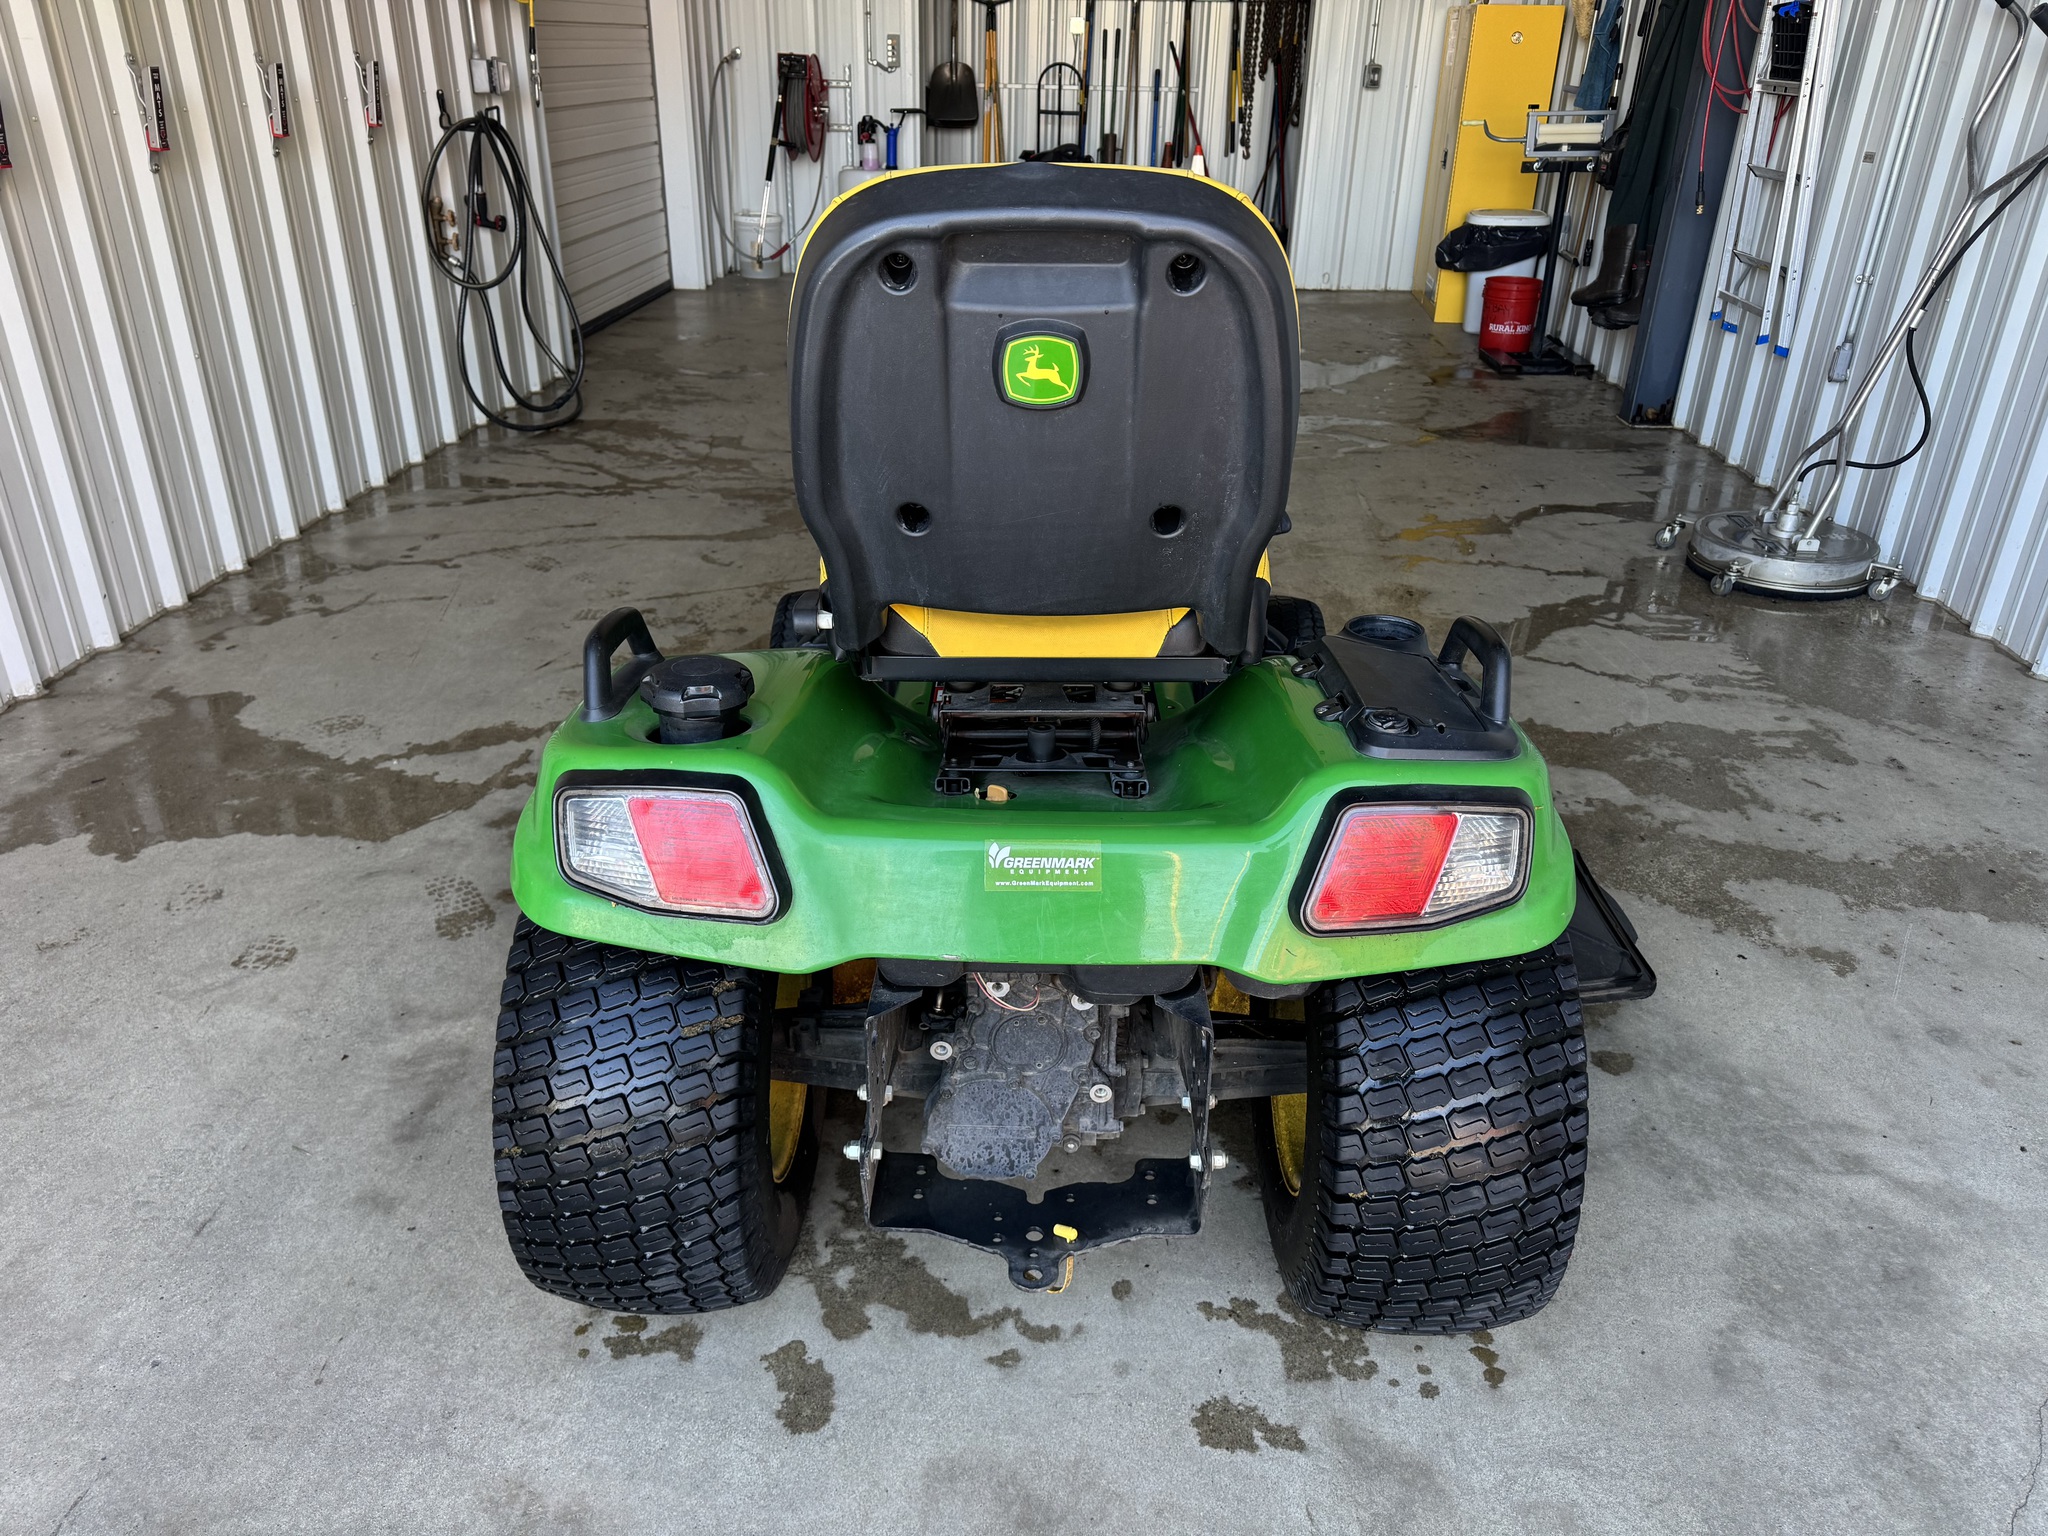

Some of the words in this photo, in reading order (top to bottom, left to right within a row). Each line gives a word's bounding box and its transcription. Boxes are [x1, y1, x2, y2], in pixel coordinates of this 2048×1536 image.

[154, 83, 163, 118] MATS
[1488, 323, 1515, 332] RURAL
[1516, 324, 1532, 332] KING
[1003, 857, 1096, 869] GREENMARK
